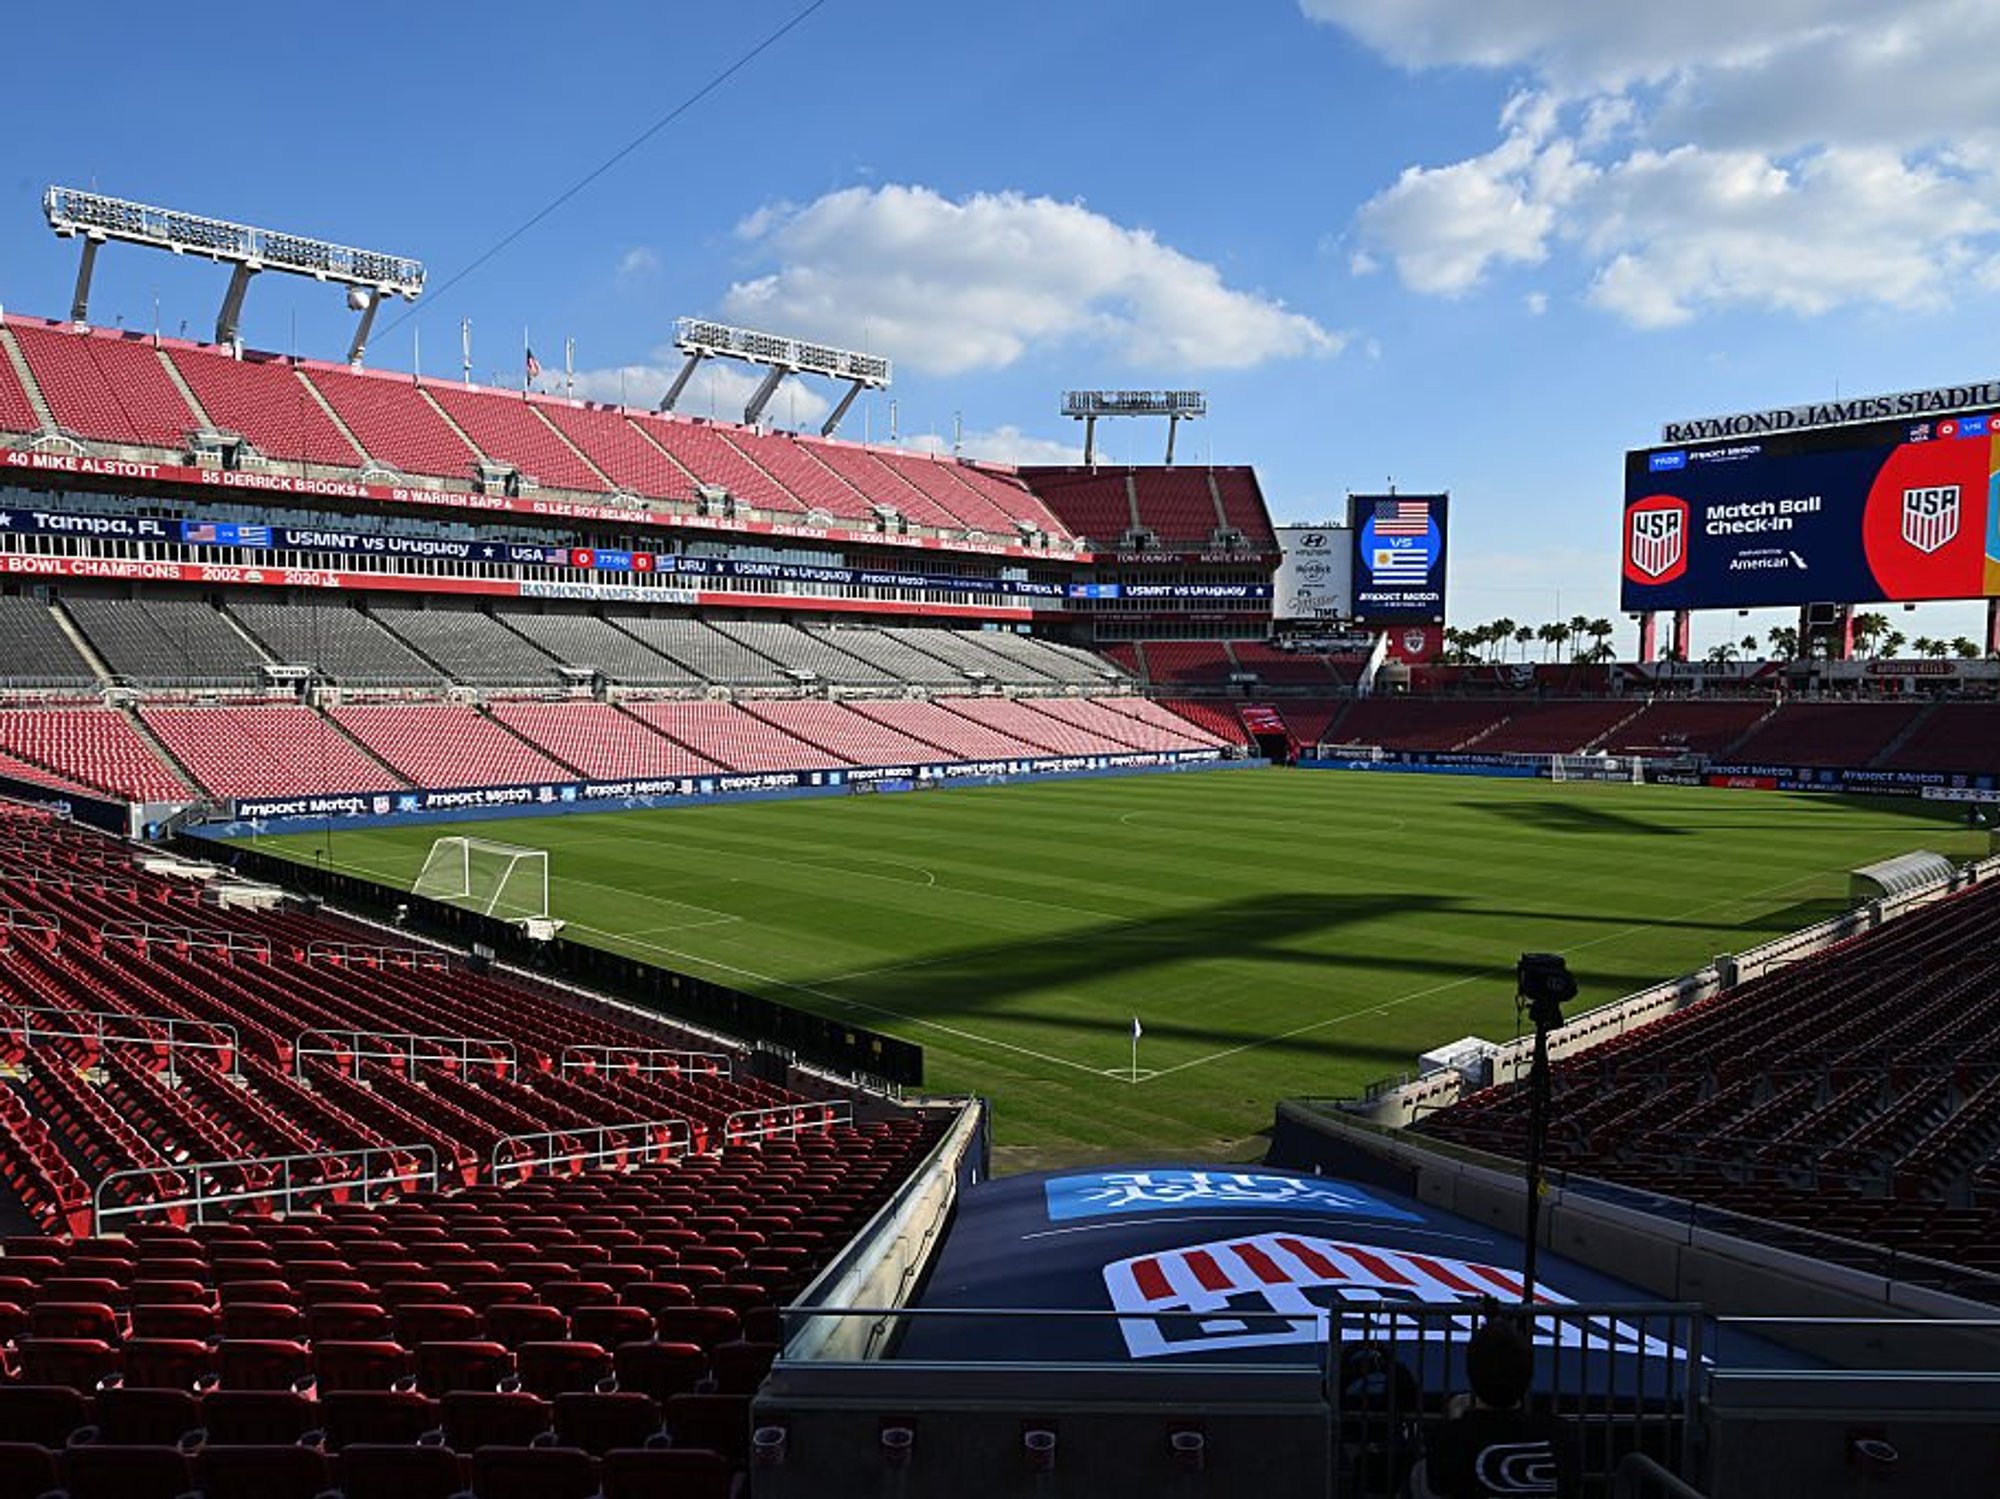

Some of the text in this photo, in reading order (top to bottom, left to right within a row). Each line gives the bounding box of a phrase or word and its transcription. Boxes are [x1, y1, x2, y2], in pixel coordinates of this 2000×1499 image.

[1665, 410, 1793, 442] RAYMOND
[1799, 397, 1891, 426] JAMES
[7, 452, 159, 477] 40 MIKE ALSTOTT
[202, 471, 357, 496] 55 DERRICK BROOKS
[393, 489, 505, 509] 99 WARREN SAPP
[1706, 496, 1822, 521] Match Ball
[1907, 489, 1957, 516] USA
[549, 503, 572, 515] LEE
[574, 505, 600, 517] ROY
[600, 507, 647, 521] SELMON
[33, 512, 166, 536] Tampa, FL
[1636, 511, 1679, 538] USA
[1706, 516, 1793, 536] Check-in
[286, 530, 360, 549] USMNT
[389, 537, 470, 557] Uruguay
[511, 547, 544, 562] USA
[577, 552, 589, 564] 0
[678, 557, 707, 572] URU
[1729, 557, 1789, 570] American
[8, 558, 68, 574] BOWL
[71, 560, 181, 579] CHAMPIONS
[202, 568, 241, 581] 2002
[284, 571, 321, 586] 2020
[734, 561, 779, 577] USMNT
[799, 567, 853, 583] Uruguay
[523, 583, 594, 598] RAYMOND
[597, 586, 640, 600] JAMES
[1126, 586, 1173, 597] USMNT
[1190, 586, 1247, 597] Uruguay
[1314, 607, 1339, 618] TIME
[585, 778, 676, 798] Impact Match
[720, 773, 799, 791] Impact Match
[240, 801, 306, 817] Impact
[310, 796, 364, 812] Match
[426, 787, 533, 806] Impact Match
